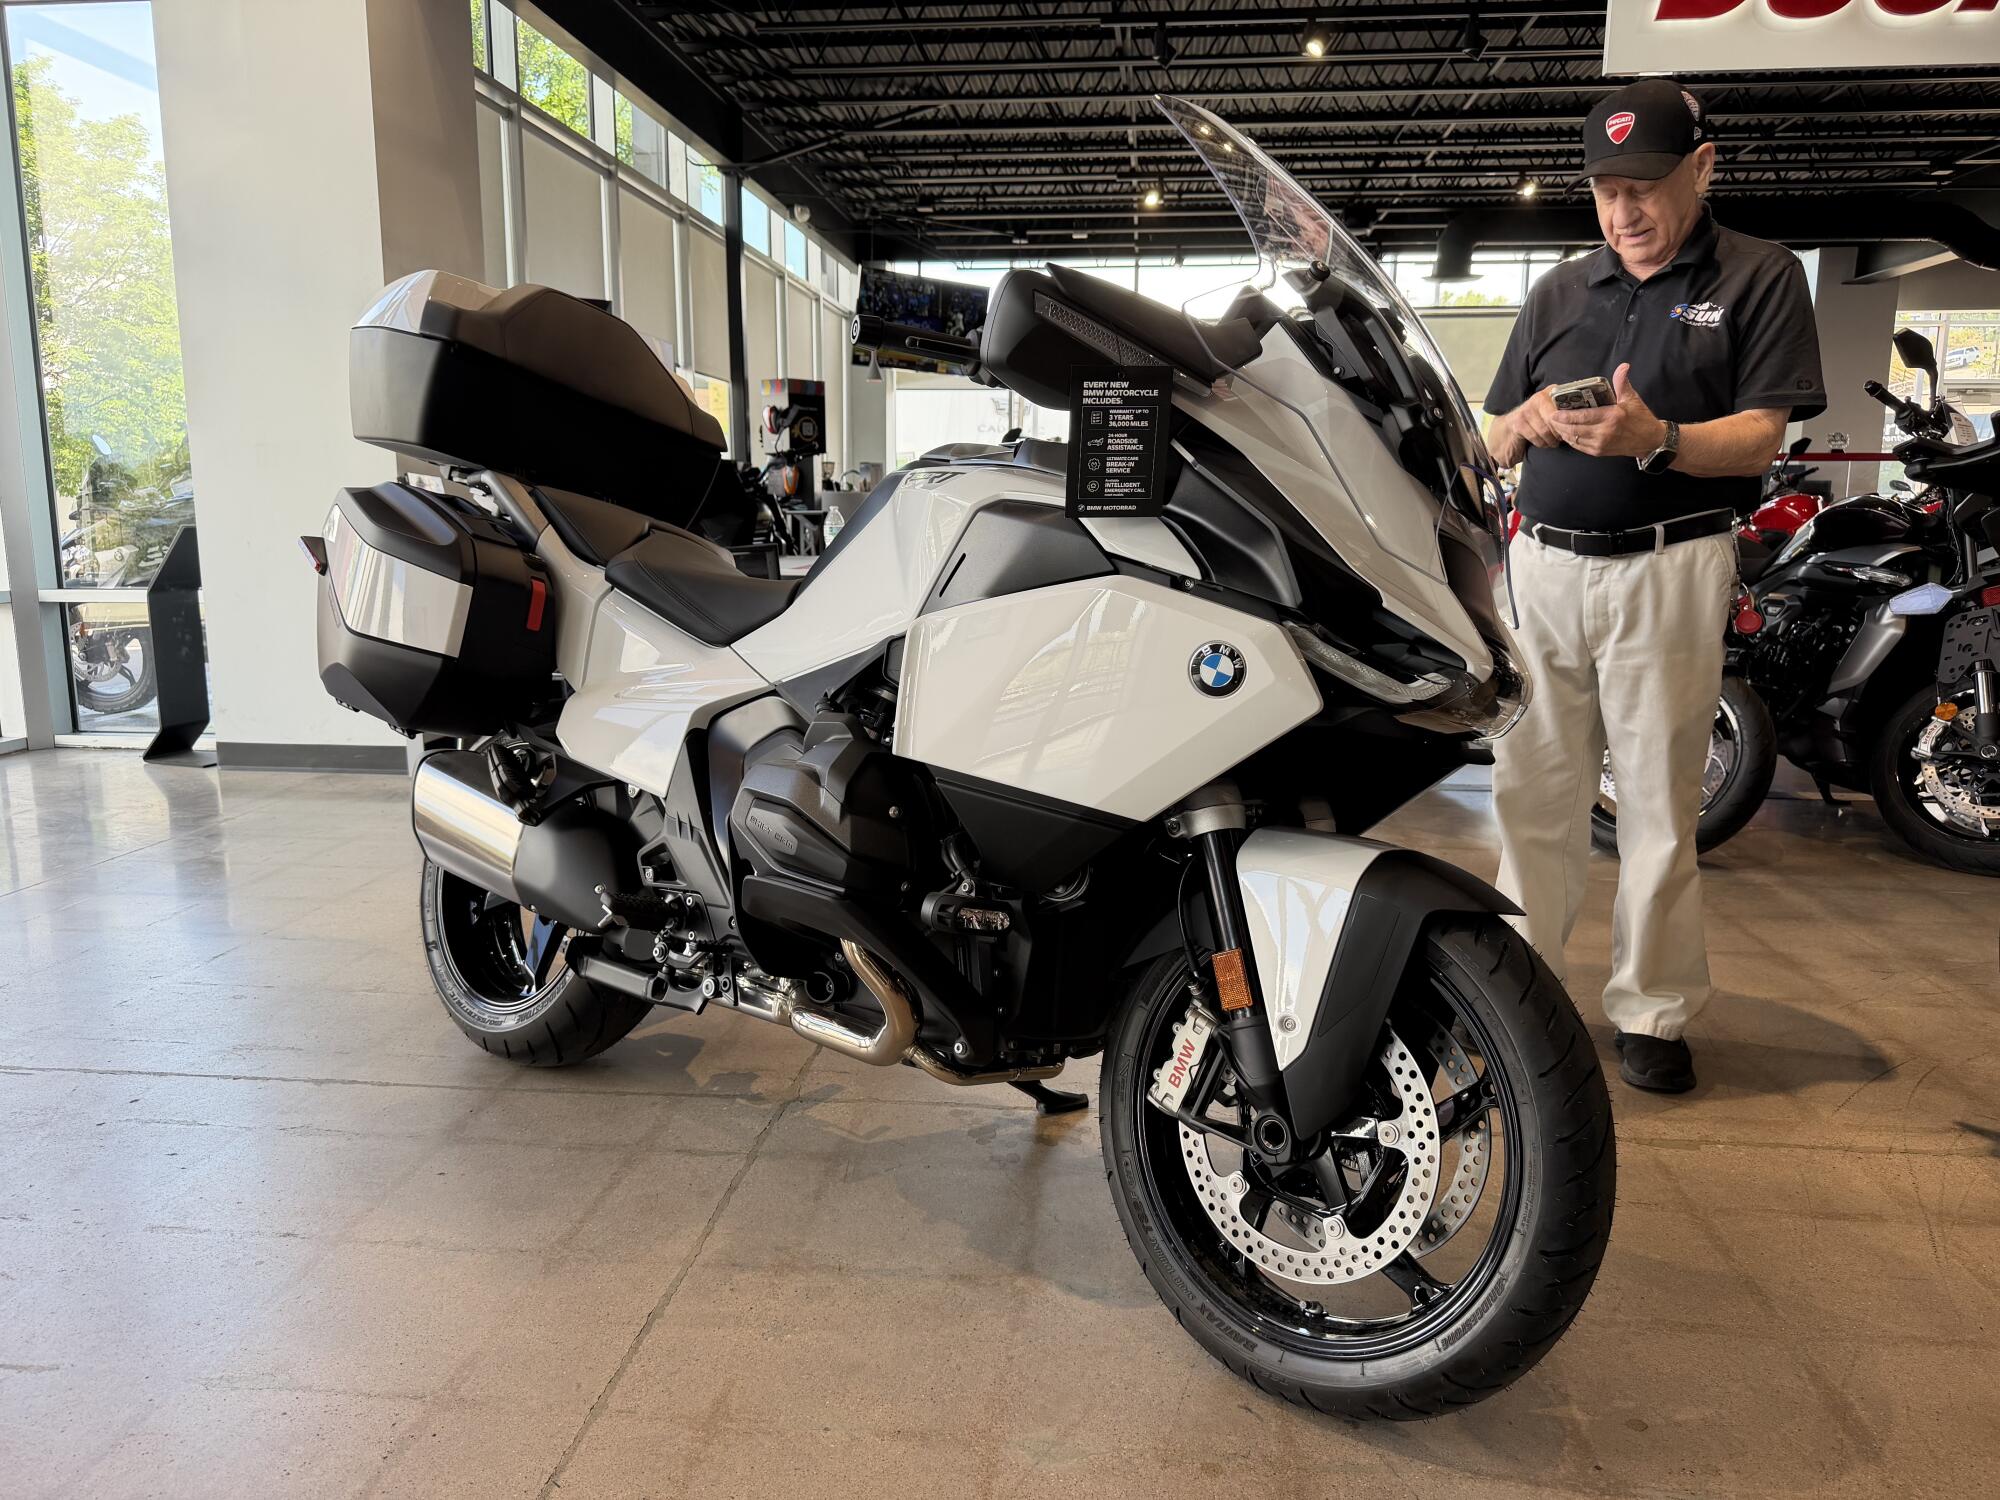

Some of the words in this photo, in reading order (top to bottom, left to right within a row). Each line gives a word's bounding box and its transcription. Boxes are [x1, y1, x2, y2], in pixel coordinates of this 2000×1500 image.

[1682, 308, 1724, 322] SUN
[1083, 389, 1104, 397] BMW
[1105, 389, 1159, 397] MOTORCYCLE
[1082, 397, 1123, 405] INCLUDES:
[1168, 1038, 1196, 1089] BMW
[1440, 1278, 1508, 1350] BRIDGESTONE
